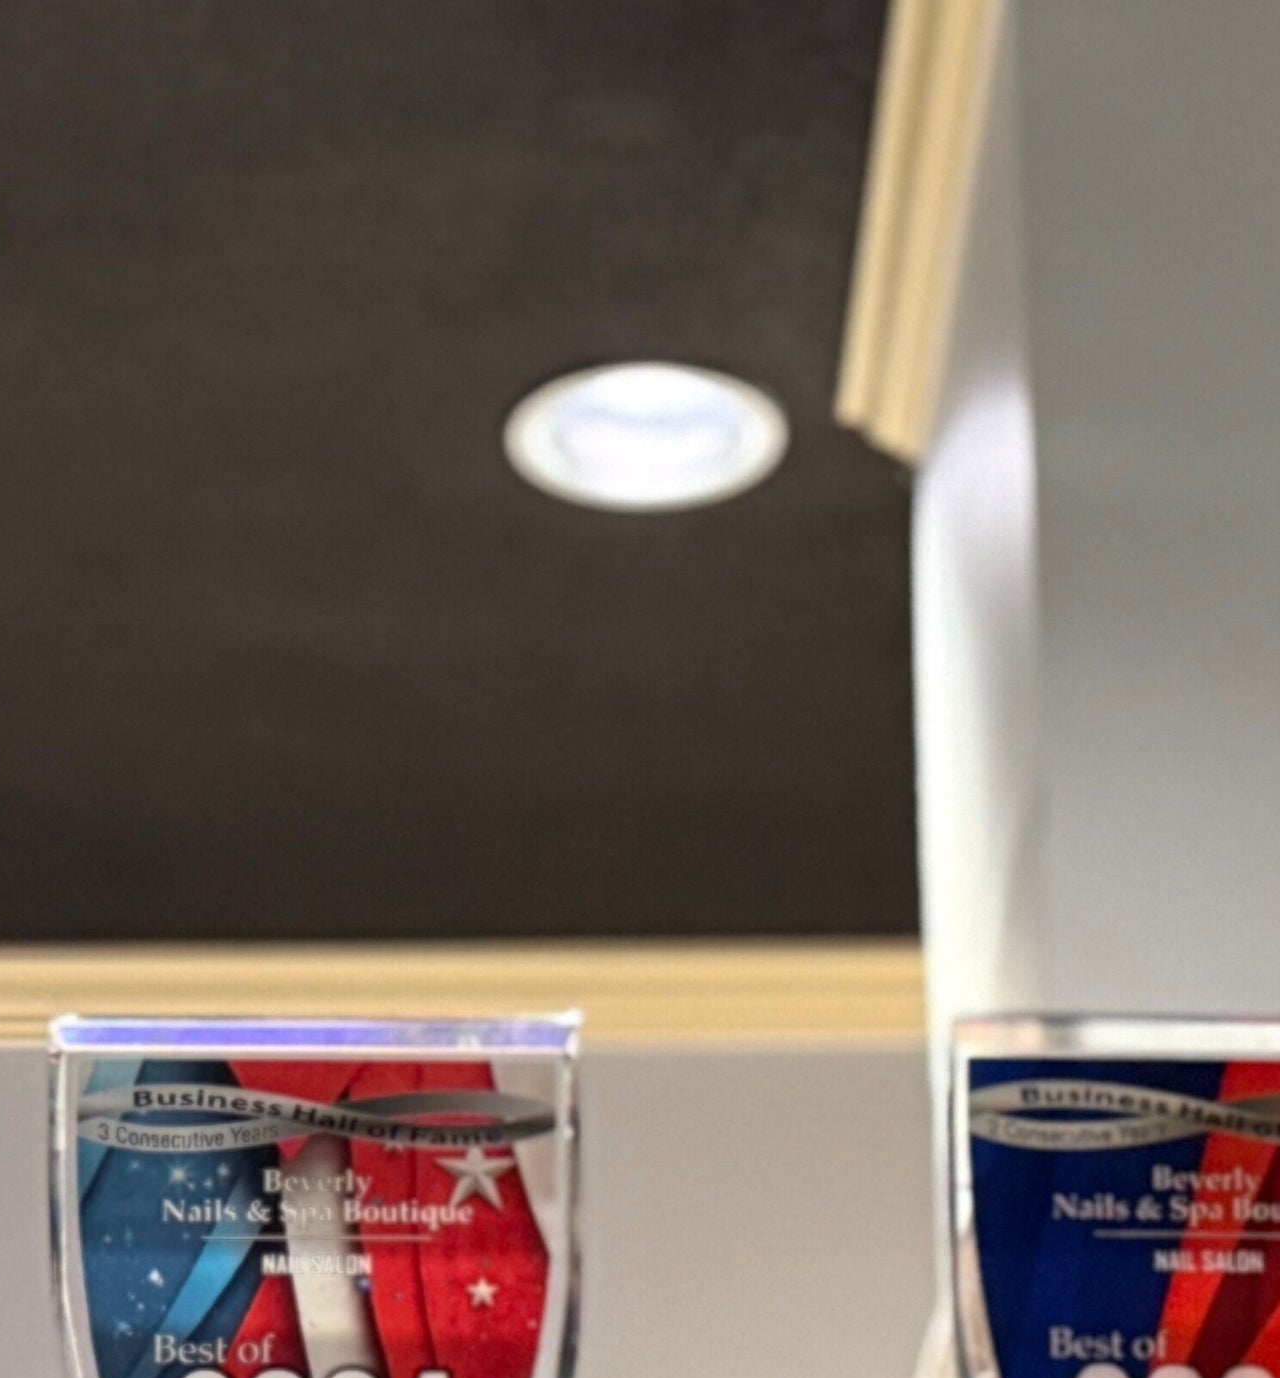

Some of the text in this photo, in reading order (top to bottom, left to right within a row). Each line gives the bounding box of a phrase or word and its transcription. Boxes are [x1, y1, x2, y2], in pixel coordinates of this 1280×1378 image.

[1021, 1085, 1169, 1115] Business
[133, 1088, 503, 1146] Business Hall of Fame
[98, 1122, 280, 1149] 3 Consecutive Years
[262, 1168, 374, 1199] Beverly
[1151, 1164, 1261, 1196] Beverly
[162, 1199, 474, 1231] Nails & Spa Boutique
[1052, 1193, 1130, 1221] Nails
[1135, 1195, 1162, 1221] &
[1169, 1195, 1224, 1228] Spa
[261, 1253, 373, 1275] NAIL SALON
[1153, 1250, 1265, 1274] NAIL SALON
[153, 1334, 277, 1364] Best of
[1048, 1325, 1169, 1361] Best of
